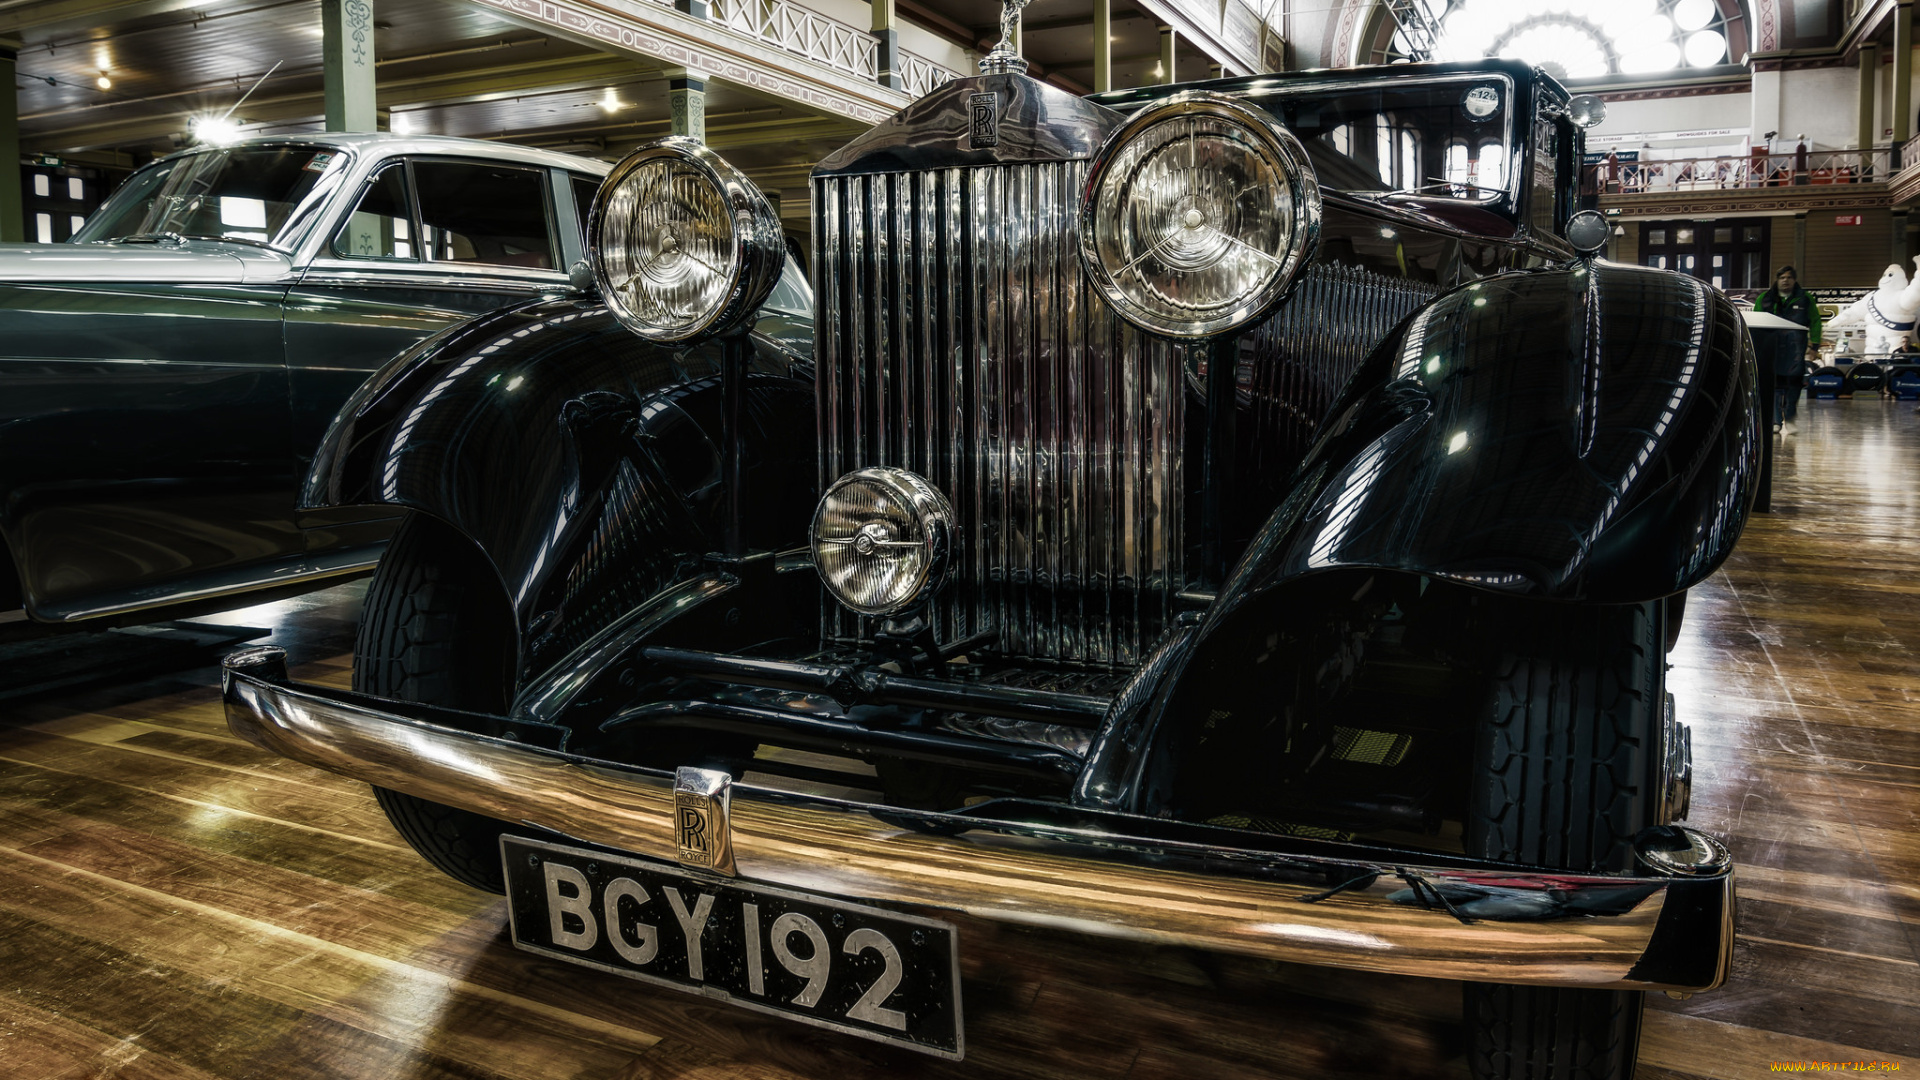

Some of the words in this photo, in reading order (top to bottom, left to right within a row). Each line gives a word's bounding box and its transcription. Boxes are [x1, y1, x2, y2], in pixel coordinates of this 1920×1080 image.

[1478, 91, 1490, 99] 12
[678, 795, 707, 806] ROLLS
[680, 851, 708, 863] ROYCE
[543, 861, 716, 981] BGY
[742, 902, 906, 1031] 192
